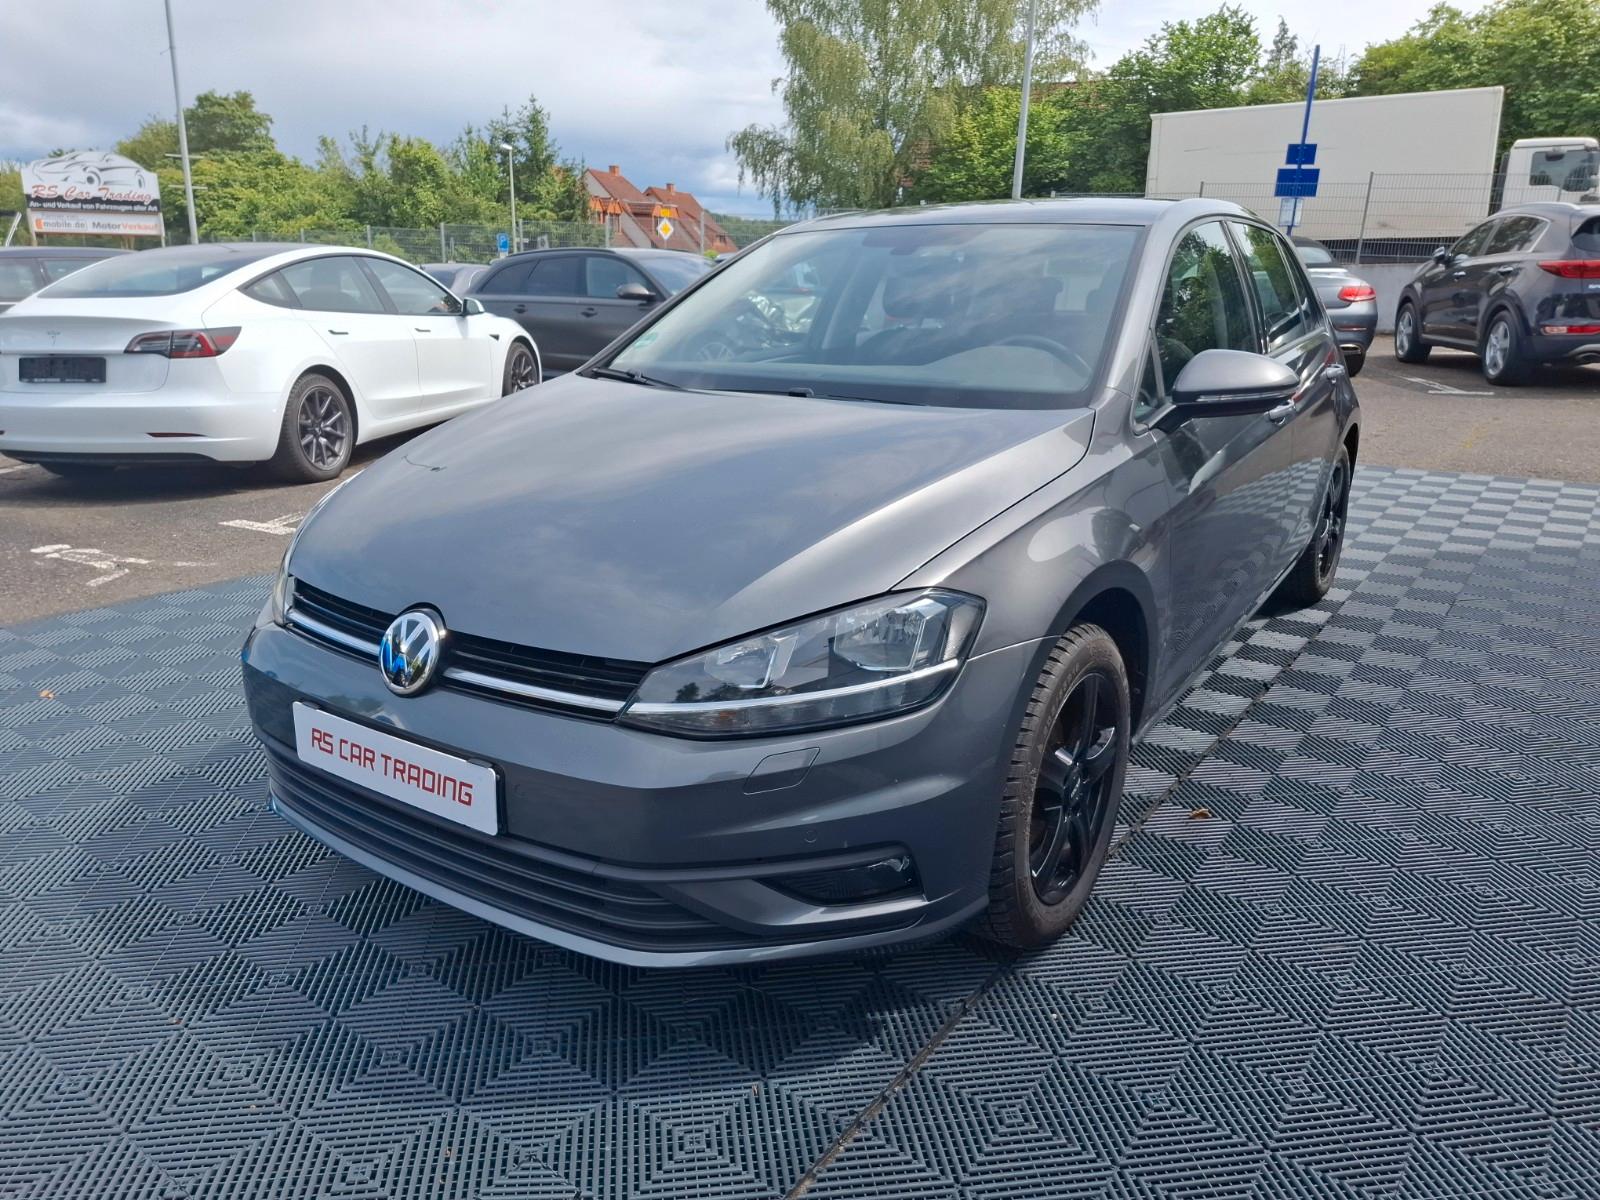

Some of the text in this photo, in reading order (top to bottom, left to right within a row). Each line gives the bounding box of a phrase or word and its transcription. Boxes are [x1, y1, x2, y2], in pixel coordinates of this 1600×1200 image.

[32, 184, 152, 204] RS Car Trading
[311, 726, 474, 807] RS CAR TRADING
